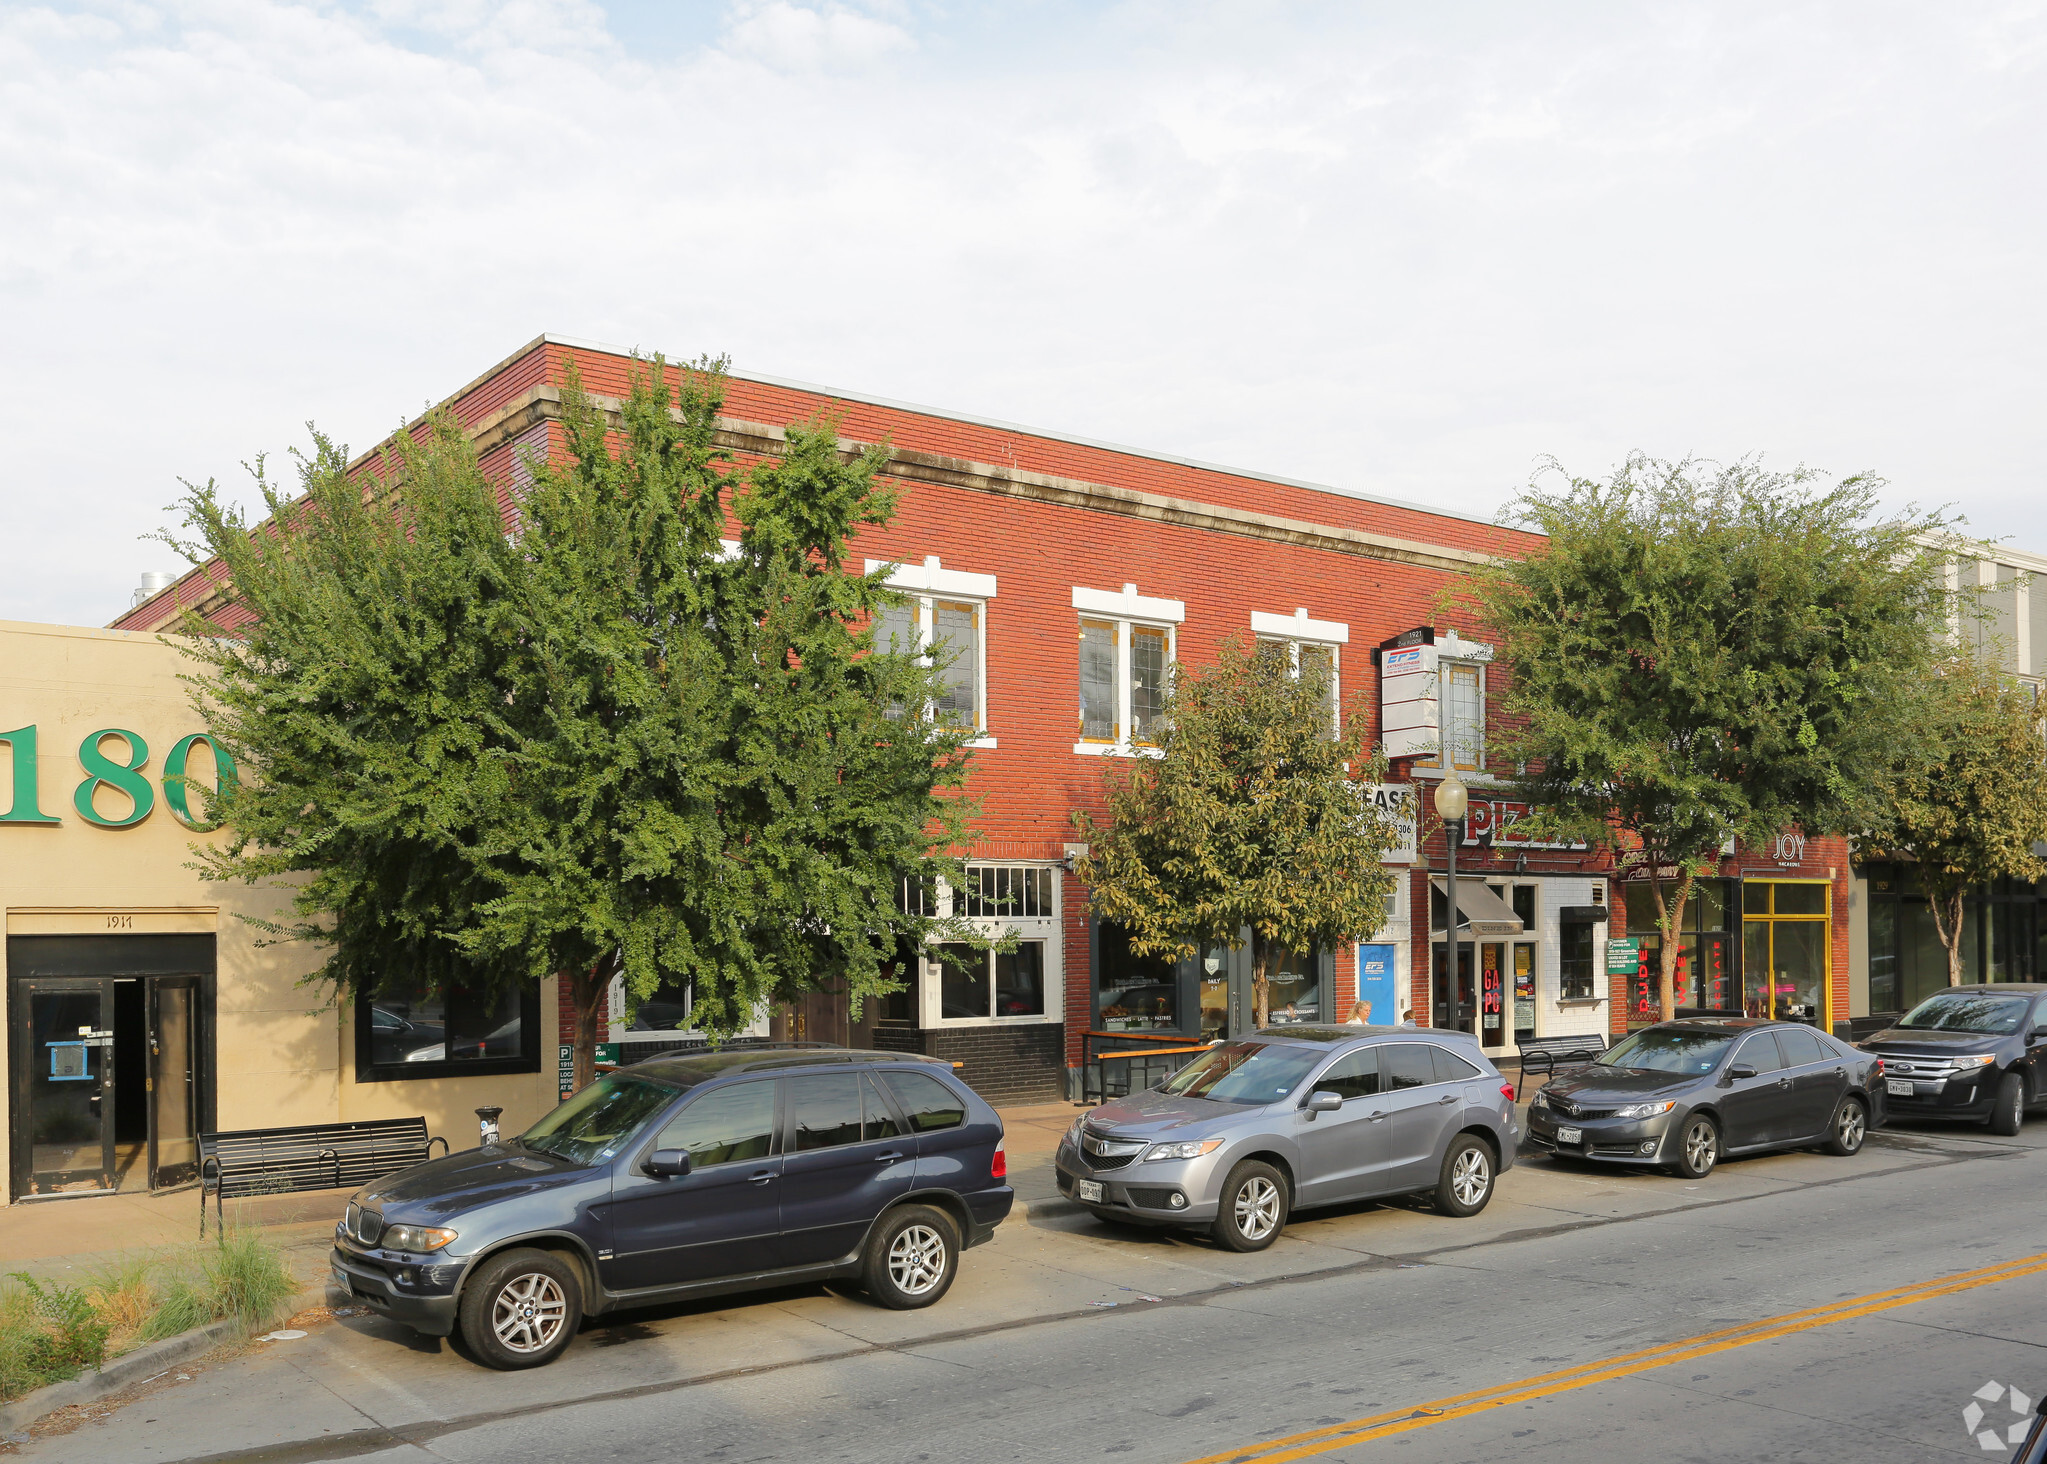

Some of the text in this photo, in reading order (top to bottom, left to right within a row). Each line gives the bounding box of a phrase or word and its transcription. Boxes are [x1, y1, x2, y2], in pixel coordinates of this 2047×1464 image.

[1409, 630, 1422, 638] 1921
[0, 724, 239, 833] 180
[1773, 833, 1806, 860] JOY
[107, 915, 133, 929] 1917
[1484, 969, 1500, 990] GA
[1677, 944, 1687, 1005] WEET
